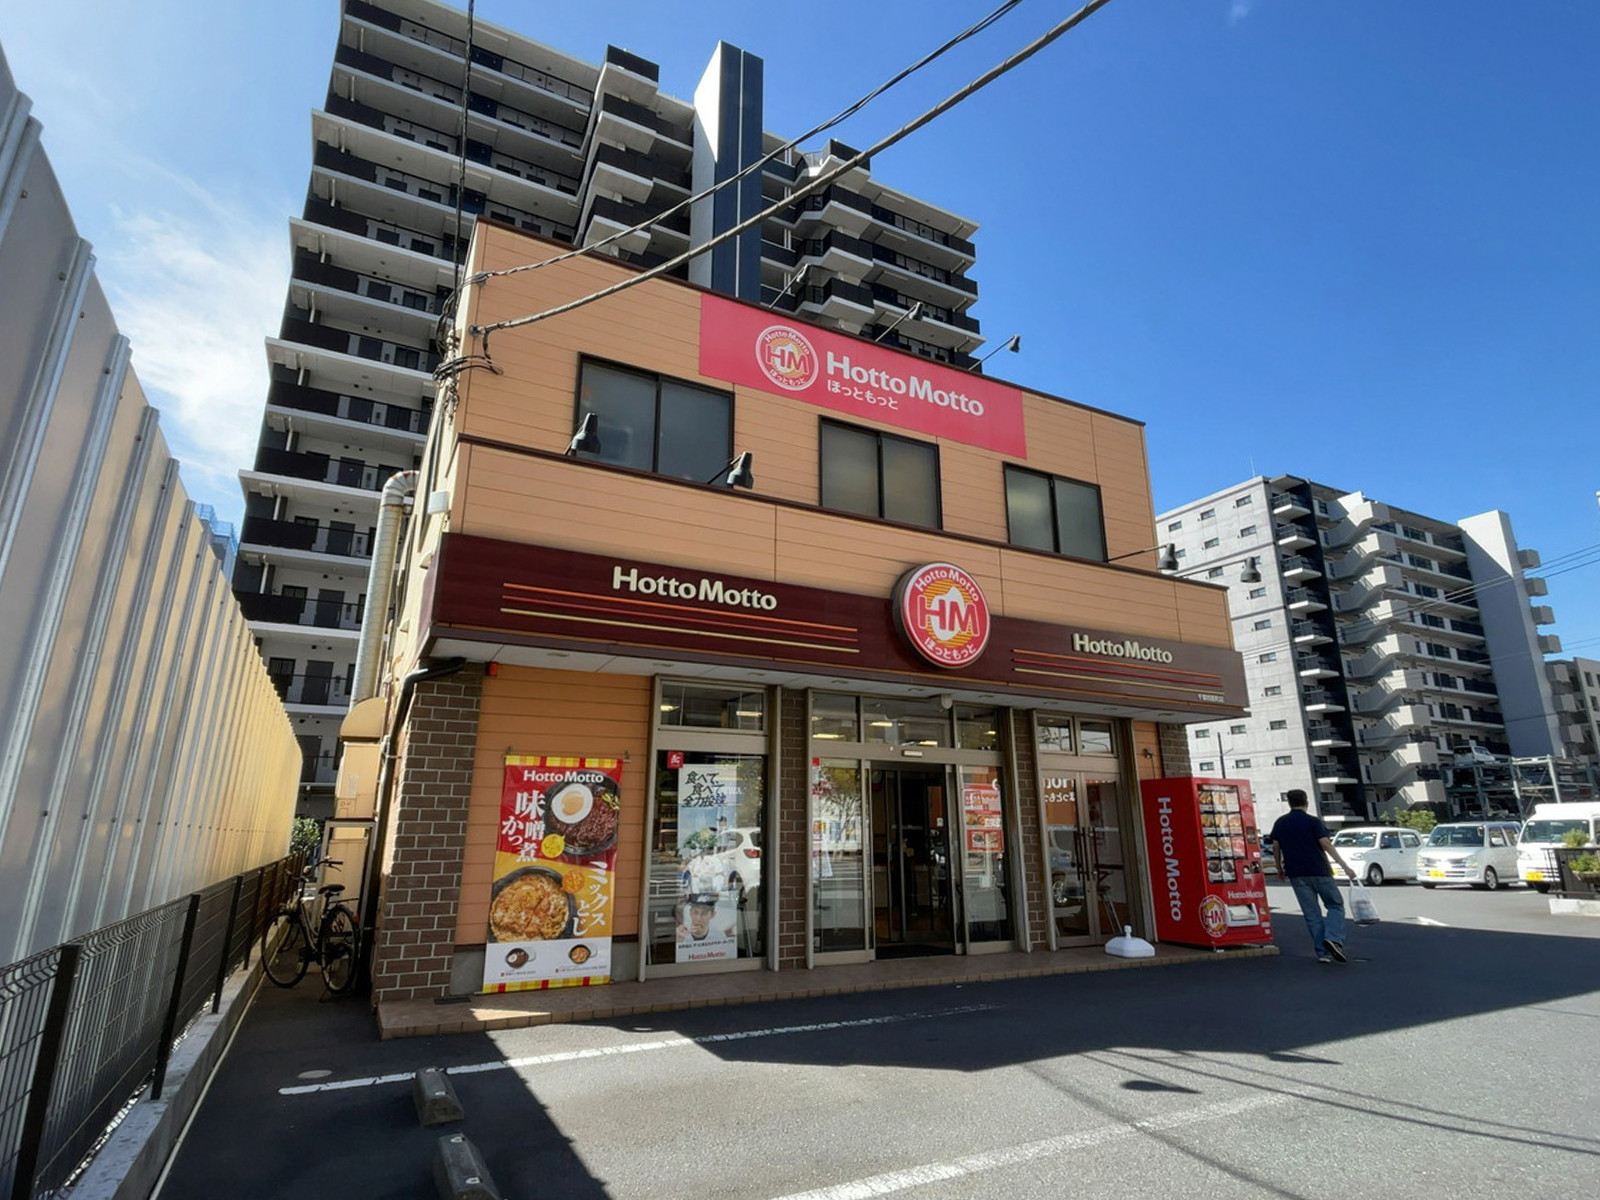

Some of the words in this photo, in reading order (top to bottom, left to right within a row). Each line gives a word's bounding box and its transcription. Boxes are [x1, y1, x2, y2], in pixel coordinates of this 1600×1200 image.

[765, 344, 810, 375] HM
[827, 379, 899, 410] ほっともっと
[917, 594, 981, 637] HM
[924, 636, 977, 660] ほっともっと
